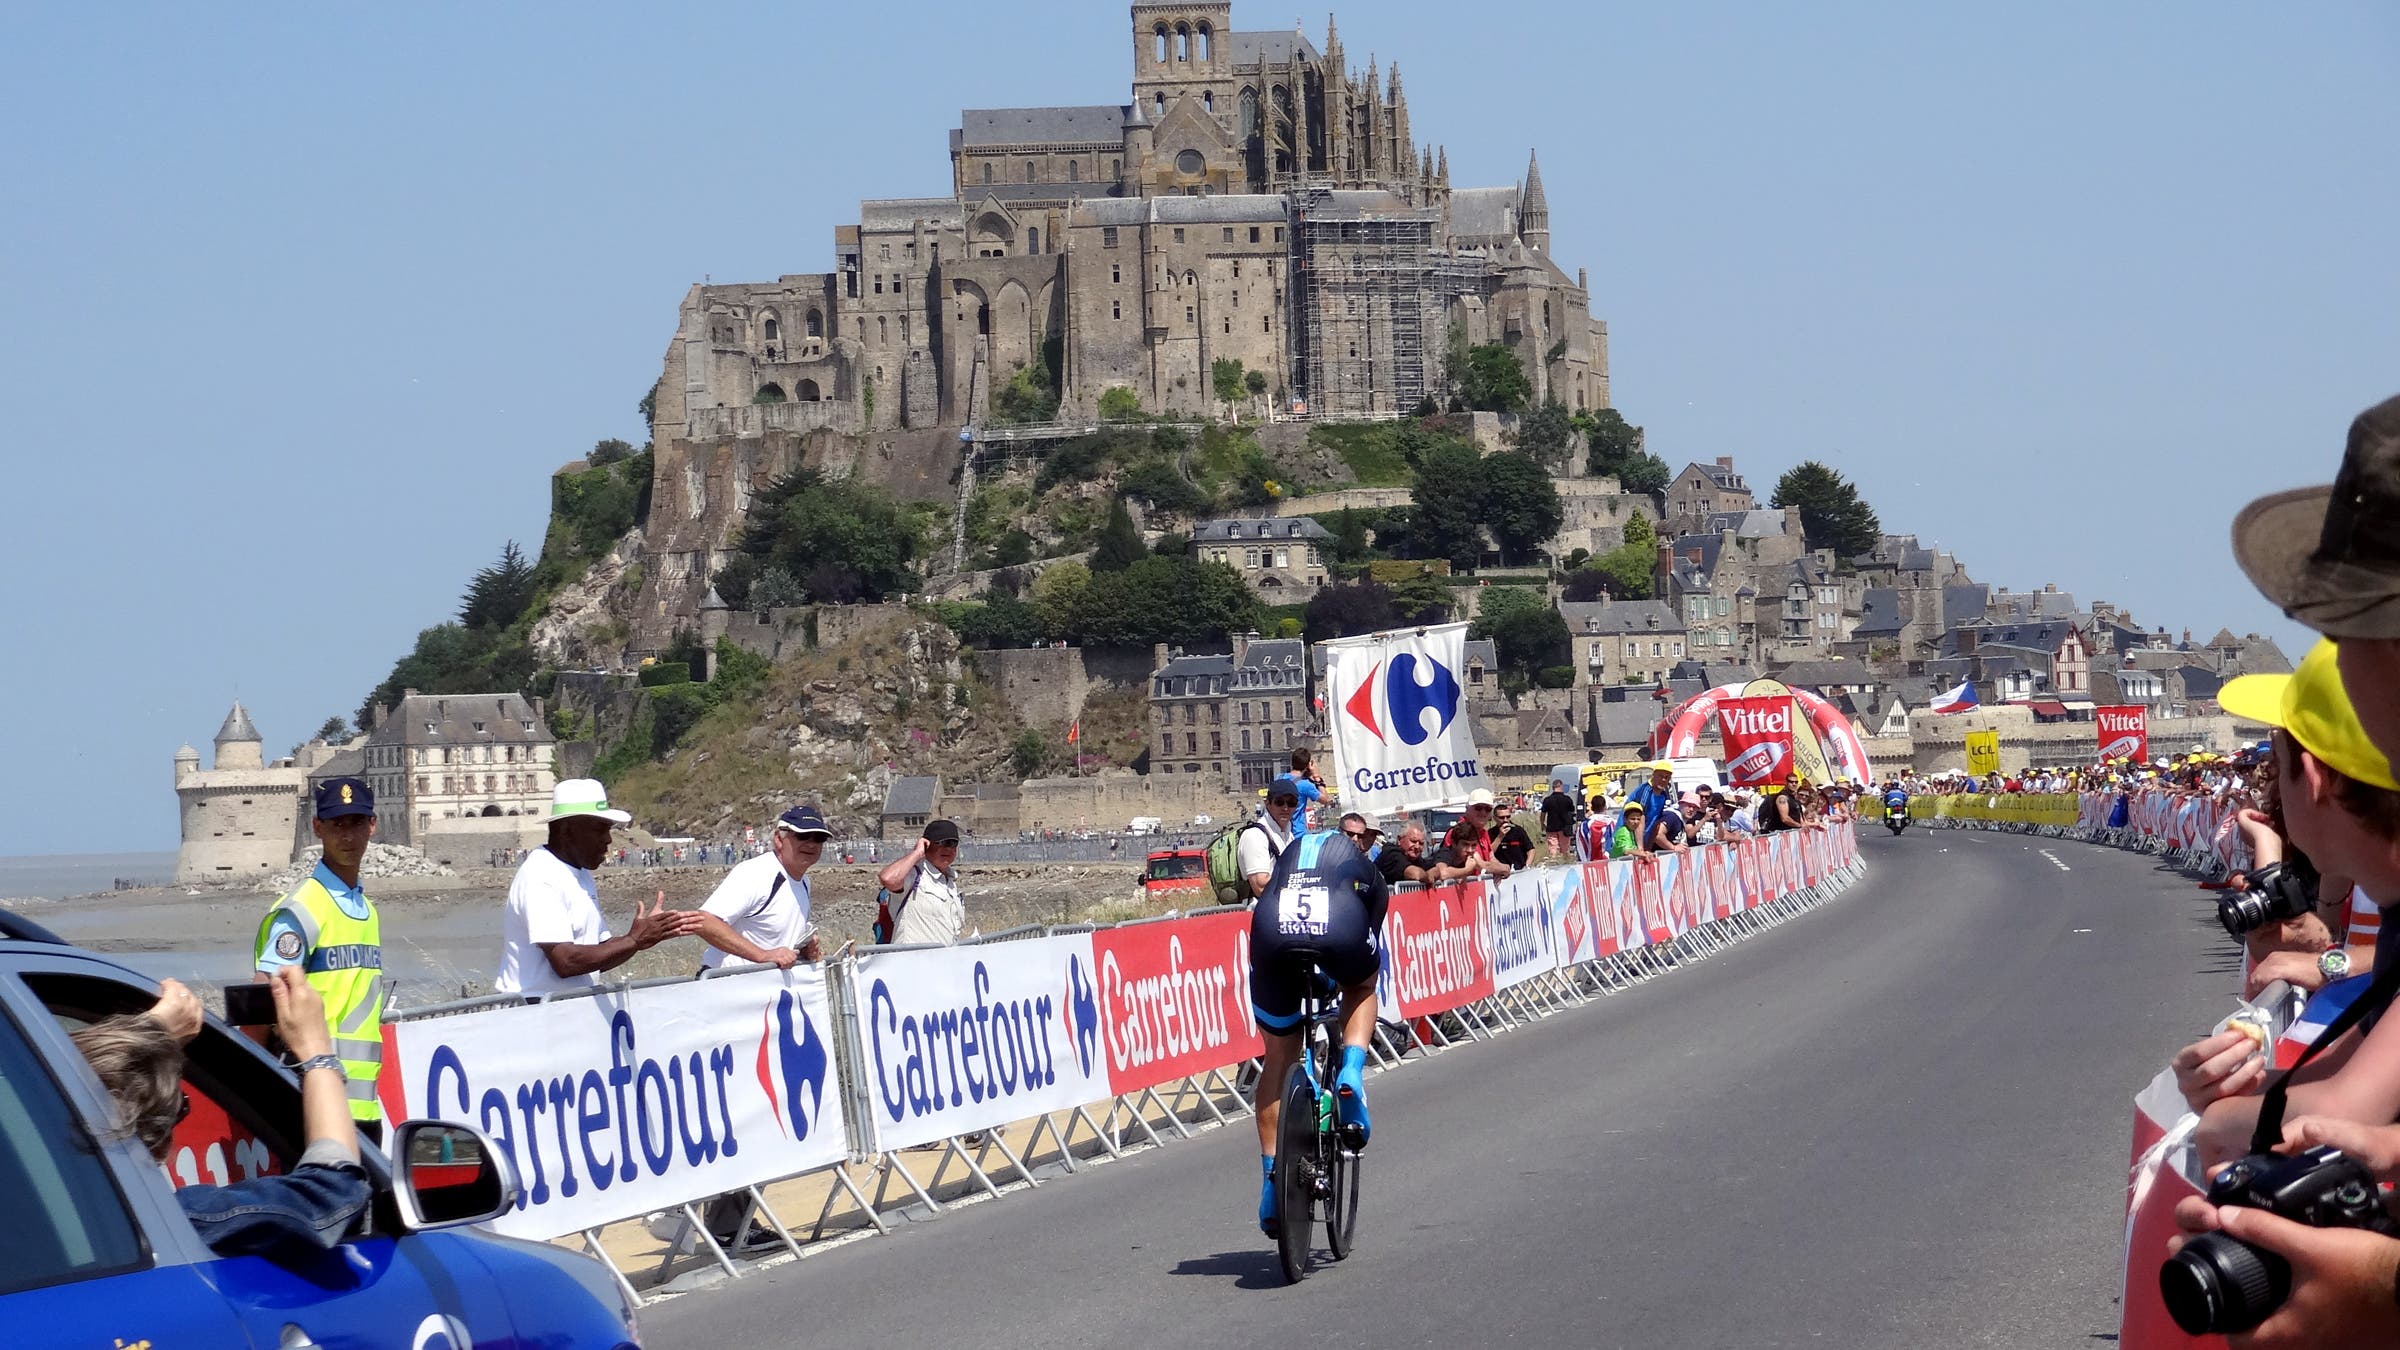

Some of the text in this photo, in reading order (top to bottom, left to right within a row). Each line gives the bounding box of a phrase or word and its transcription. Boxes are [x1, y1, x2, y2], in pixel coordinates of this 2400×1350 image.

[1719, 705, 1791, 736] Vittel
[2098, 711, 2144, 732] Vittel
[1740, 750, 1772, 773] Vittel
[1971, 745, 1995, 756] LCL
[2108, 742, 2130, 758] Vittel
[1354, 757, 1479, 792] Carrefour
[1296, 893, 1311, 921] 5
[1489, 884, 1538, 975] Carrefour
[1393, 900, 1475, 1004] Carrefour
[1101, 934, 1229, 1072] Carrefour
[871, 961, 1055, 1123] Carrefour
